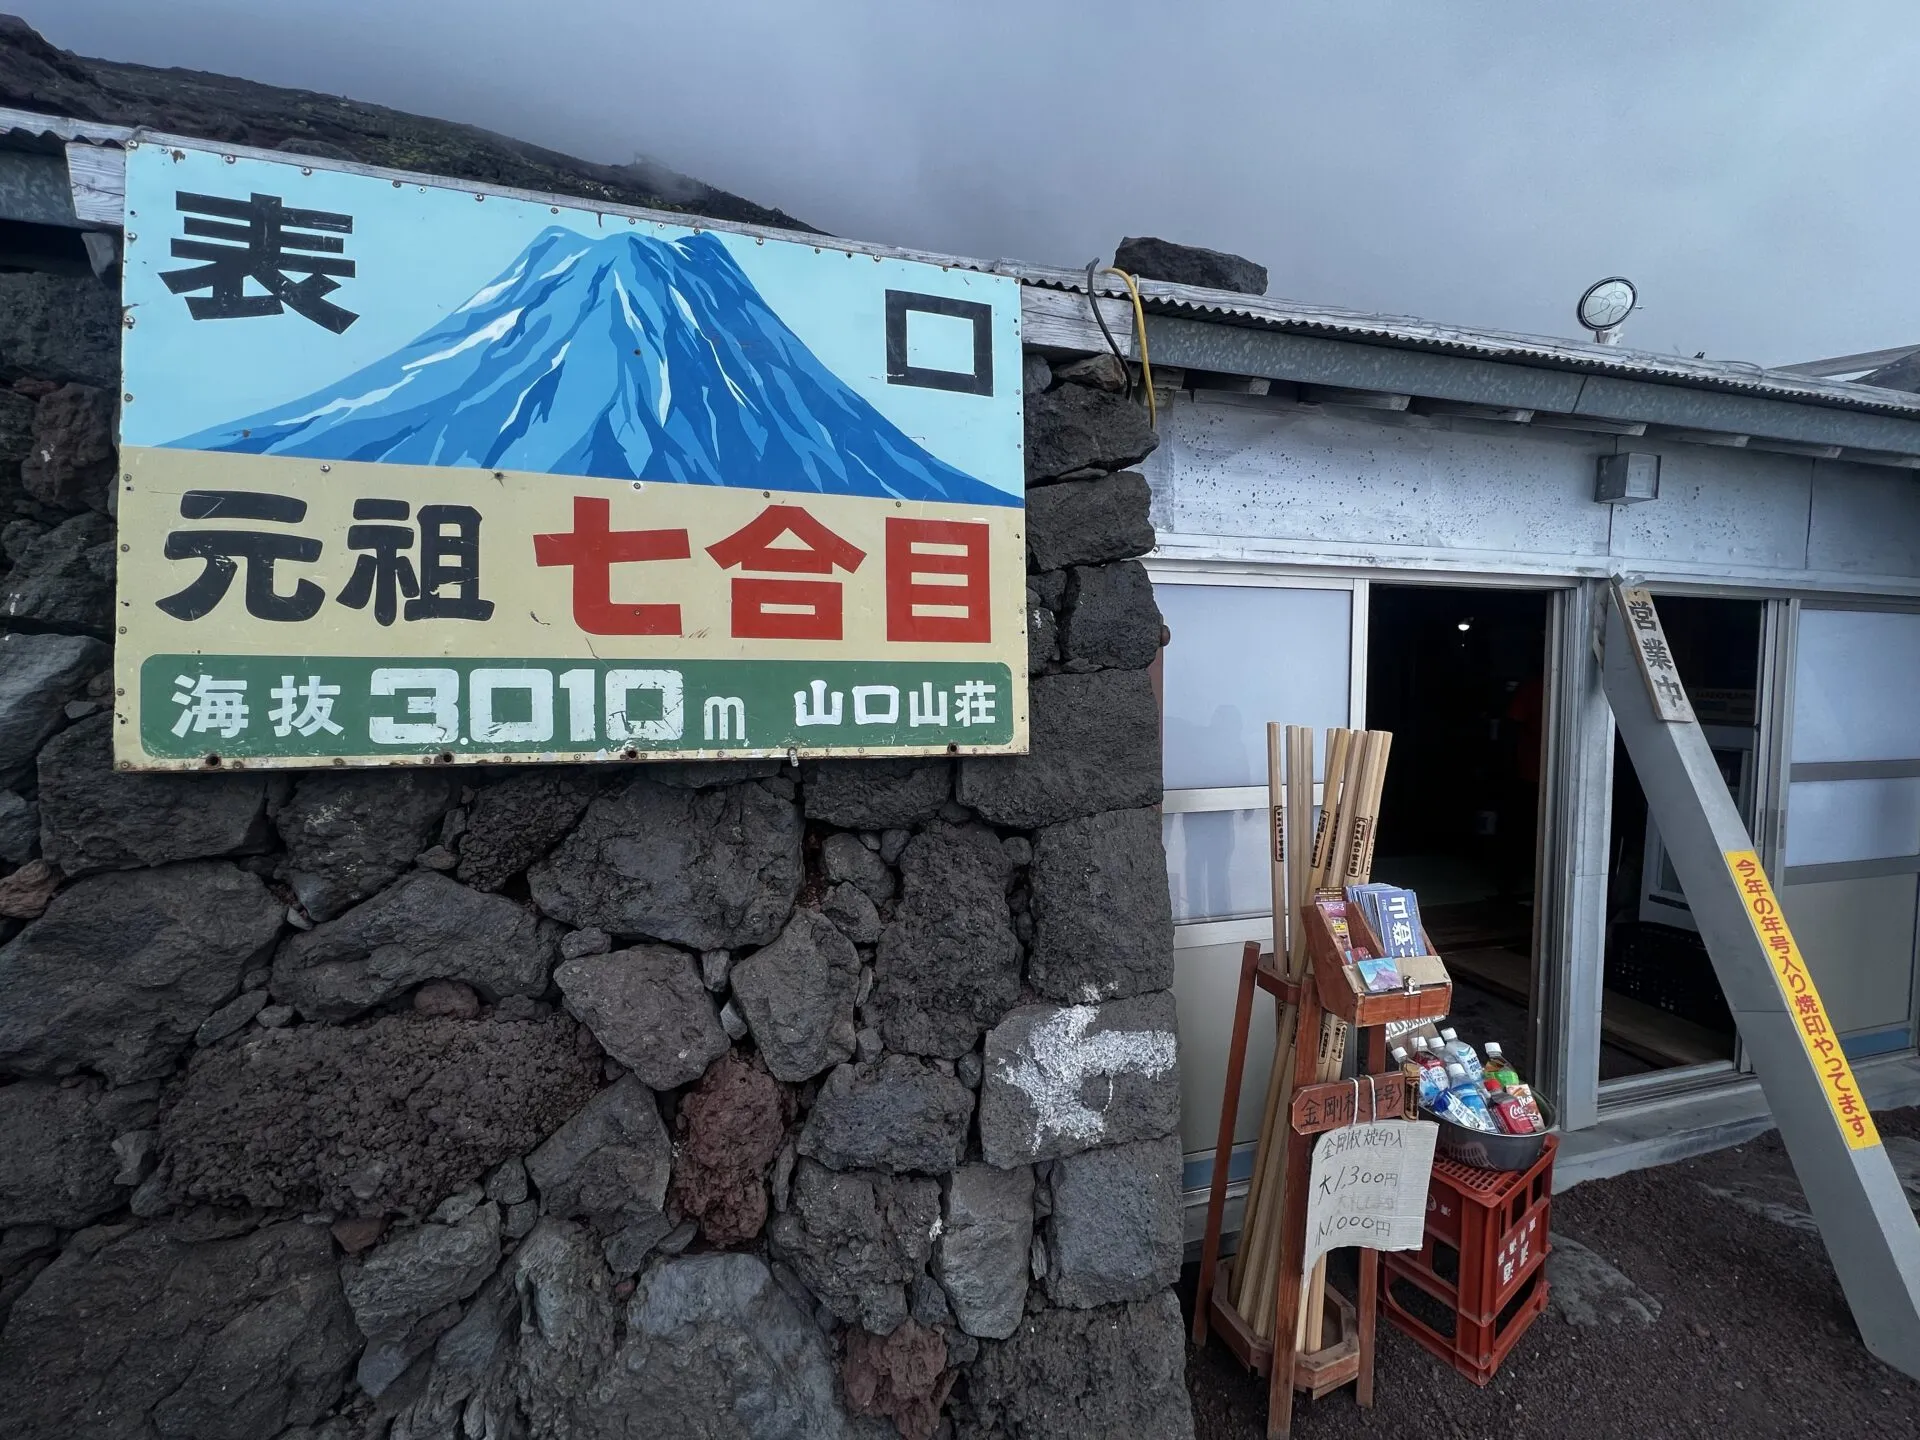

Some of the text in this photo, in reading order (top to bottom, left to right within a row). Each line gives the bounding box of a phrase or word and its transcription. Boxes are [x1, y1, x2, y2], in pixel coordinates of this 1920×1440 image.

[158, 191, 994, 397] 表 口
[793, 680, 996, 727] 山口山荘
[1629, 600, 1684, 708] 営業中
[1736, 859, 1865, 1138] 今年の年号入り焼印やってます
